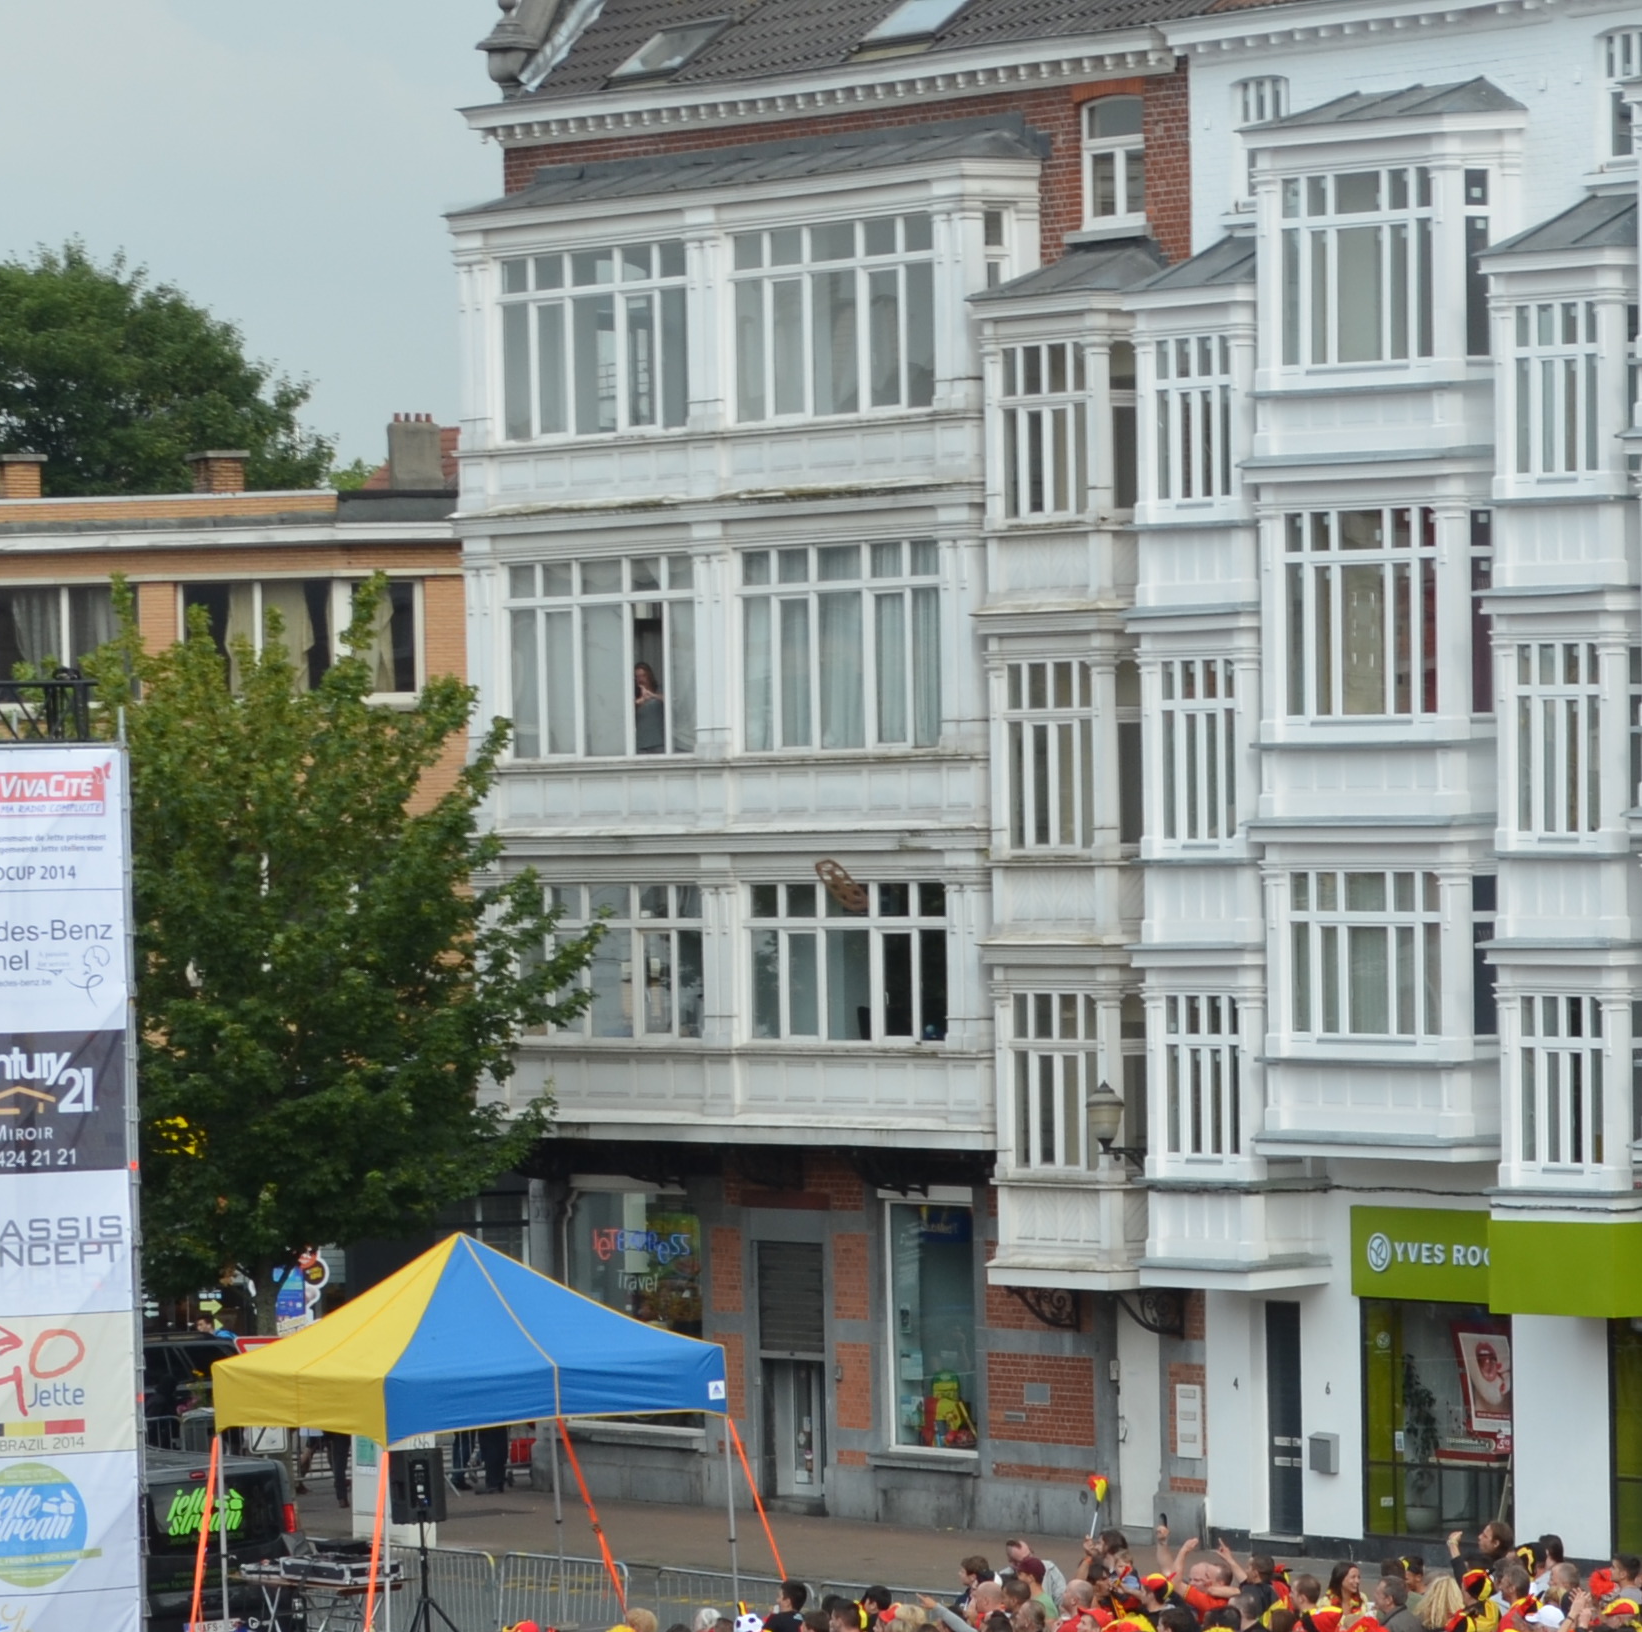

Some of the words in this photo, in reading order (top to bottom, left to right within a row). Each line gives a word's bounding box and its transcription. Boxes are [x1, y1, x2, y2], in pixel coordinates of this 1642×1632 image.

[40, 865, 76, 880] 2014
[58, 1067, 94, 1113] 21
[32, 1150, 50, 1165] 21
[58, 1148, 76, 1164] 21
[1394, 1241, 1445, 1266] YVES
[617, 1270, 659, 1293] Travel
[1233, 1377, 1239, 1391] 4
[1325, 1381, 1331, 1395] 6
[27, 1383, 85, 1408] Jette
[0, 1437, 47, 1451] BRAZIL
[53, 1435, 85, 1450] 2014
